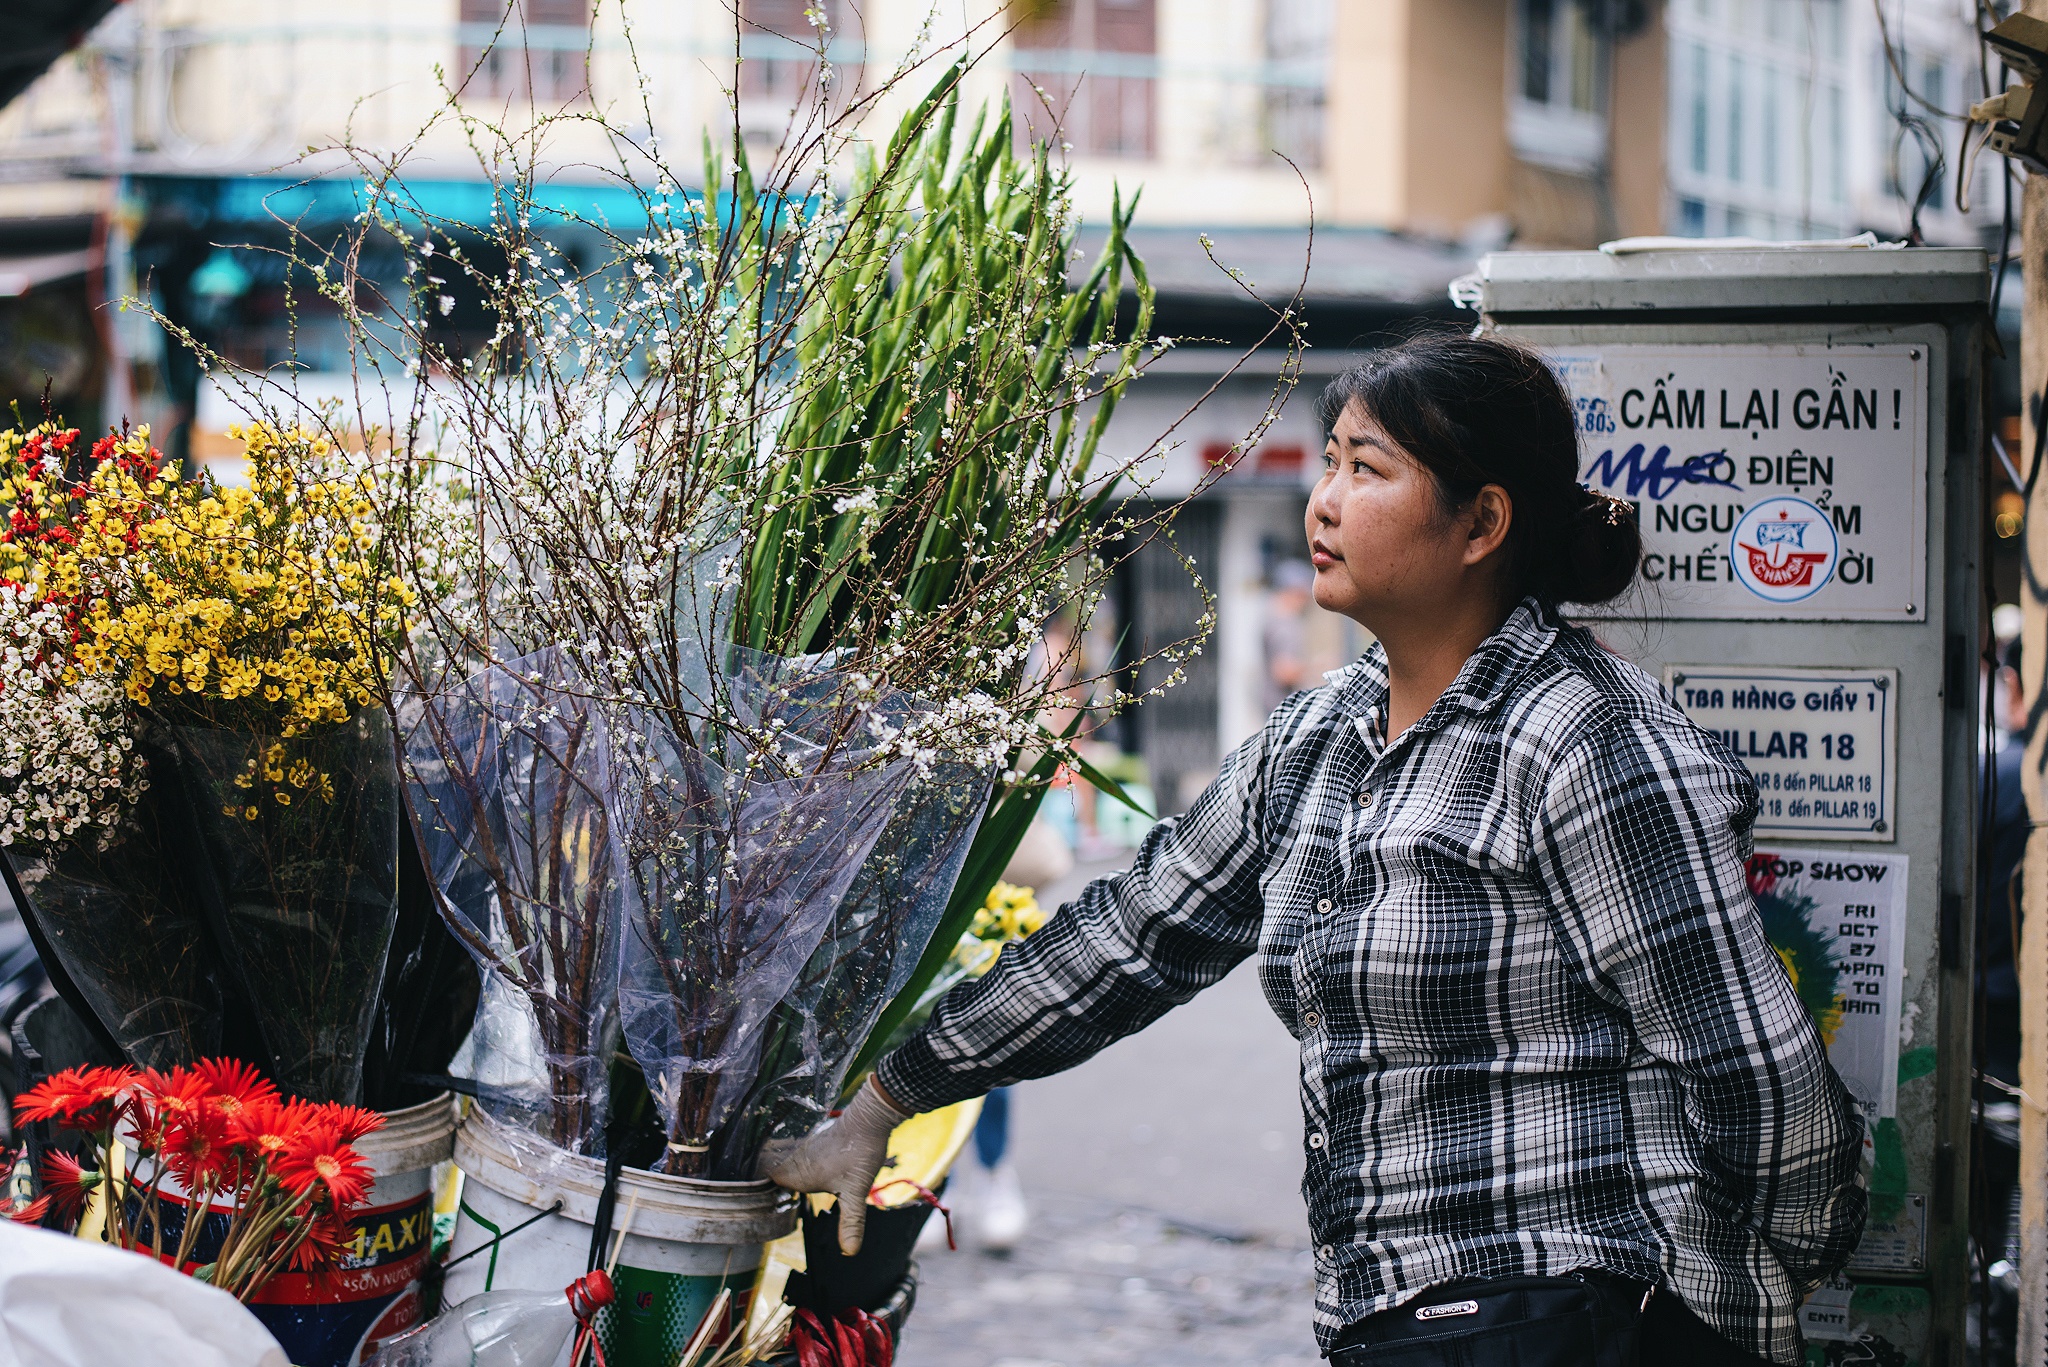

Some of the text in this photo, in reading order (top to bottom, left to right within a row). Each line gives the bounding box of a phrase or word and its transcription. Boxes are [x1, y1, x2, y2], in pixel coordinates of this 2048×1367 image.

[1620, 372, 1705, 429] CẤM
[1720, 389, 1779, 440] LẠI
[1792, 370, 1878, 430] GẦN
[1747, 449, 1834, 492] ĐIỆN
[1684, 689, 1724, 709] TBA
[1732, 685, 1796, 711] HÀNG
[1867, 693, 1875, 712] 1
[1821, 734, 1855, 760] 18
[1773, 773, 1781, 791] 8
[1783, 771, 1806, 791] đến
[1809, 773, 1855, 793] PILLAR
[1858, 776, 1872, 793] 18
[1769, 799, 1783, 817] 18
[1788, 797, 1811, 818] đến
[1814, 800, 1859, 819] PILLAR
[1862, 801, 1876, 820] 19
[1809, 860, 1888, 883] SHOW
[1843, 904, 1876, 919] FRI
[1839, 923, 1879, 938] OCT
[1849, 942, 1876, 957] 27
[1839, 961, 1885, 977] 4PM
[1852, 981, 1879, 995] TO
[1431, 1304, 1462, 1316] FASHION
